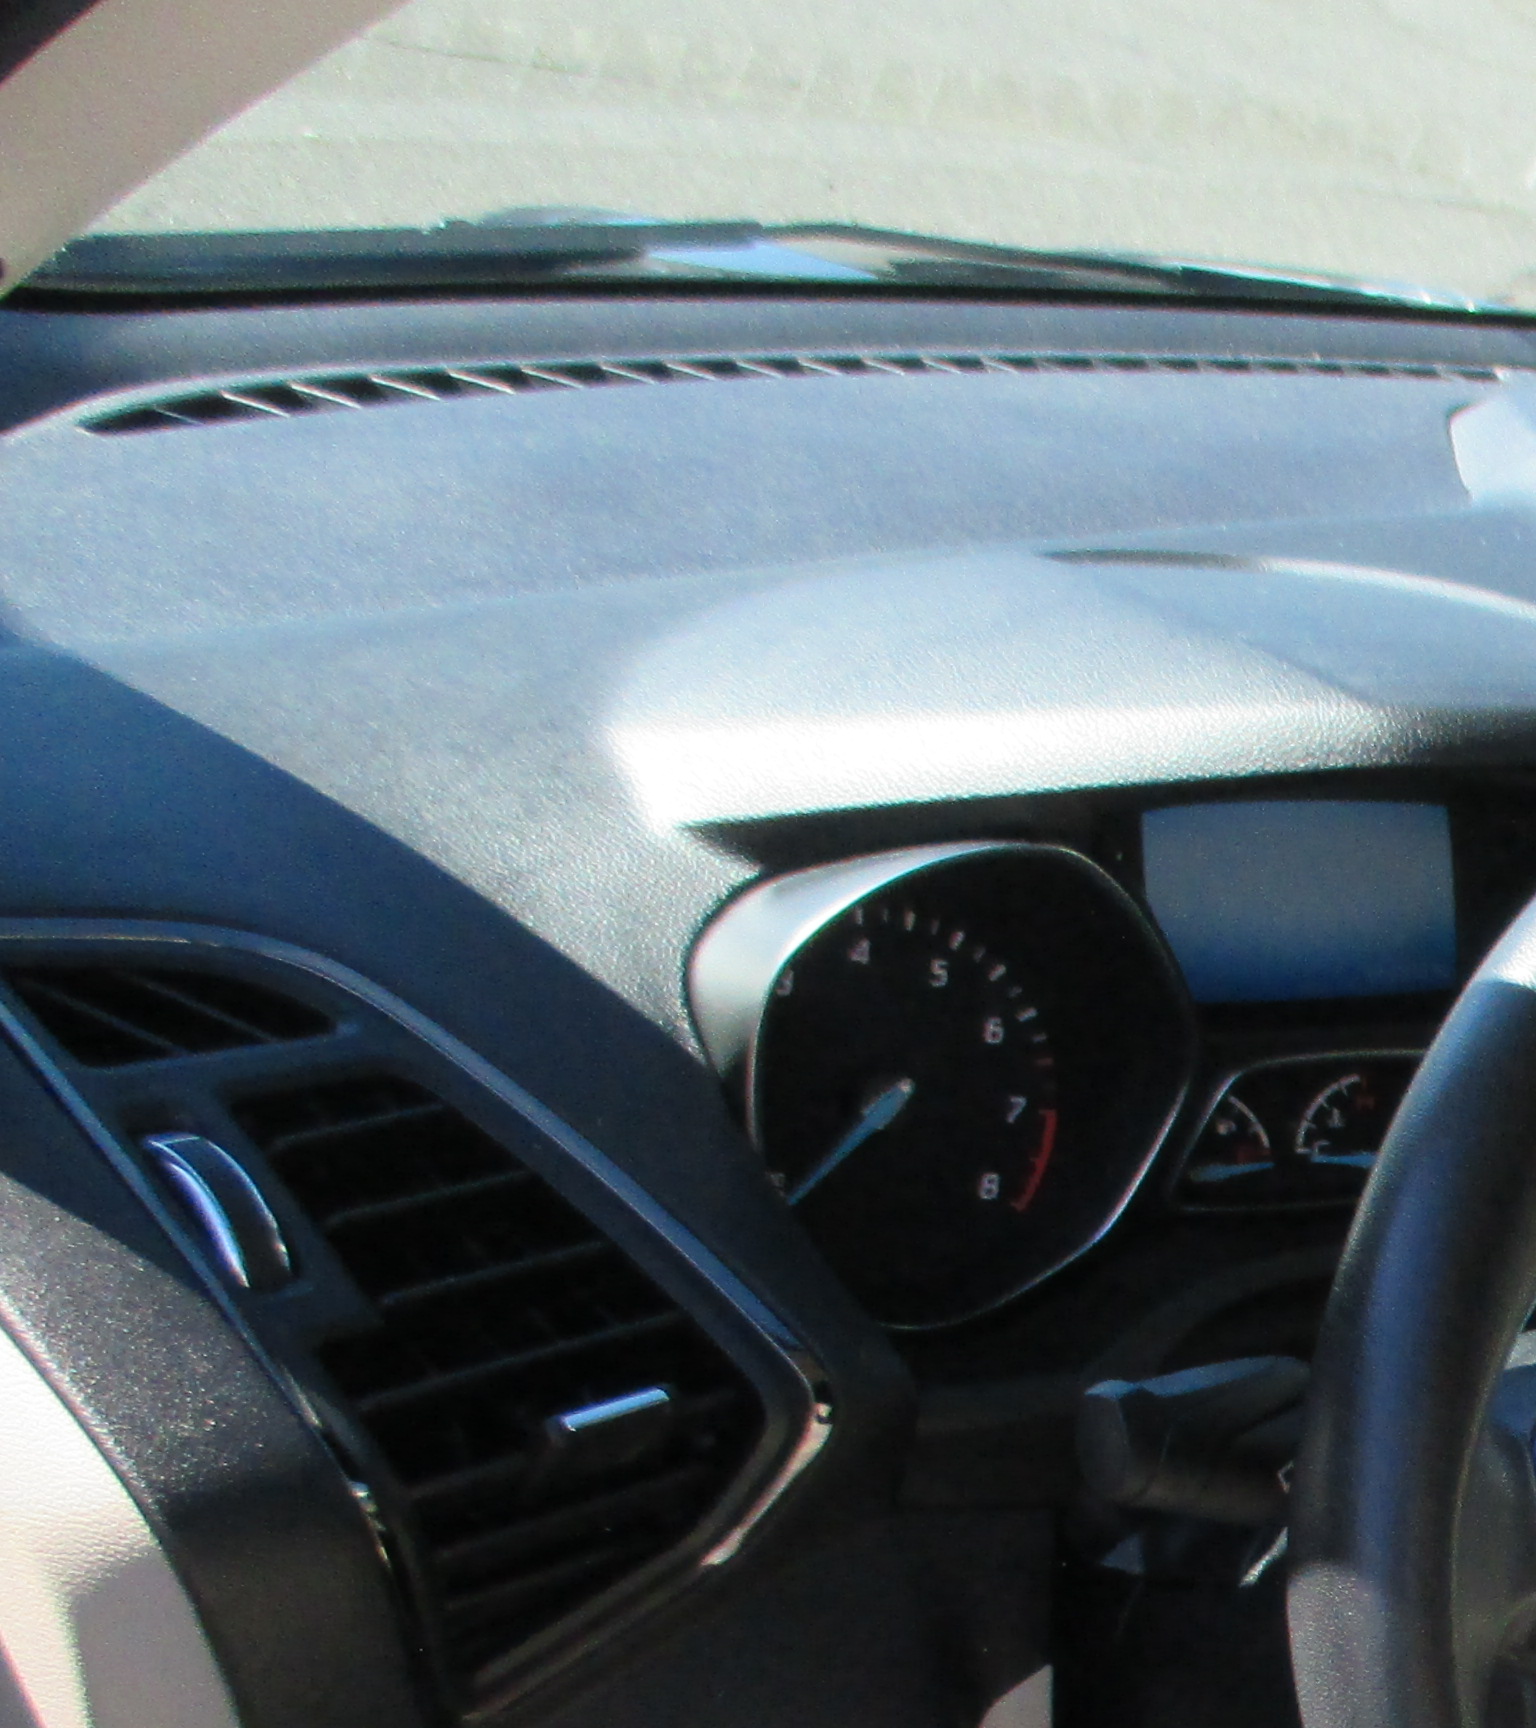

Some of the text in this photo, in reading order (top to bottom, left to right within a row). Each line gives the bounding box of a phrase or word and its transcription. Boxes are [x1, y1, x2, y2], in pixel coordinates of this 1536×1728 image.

[929, 957, 949, 988] 5
[983, 1016, 1004, 1044] 6
[1006, 1095, 1027, 1124] 7
[977, 1172, 1000, 1200] 8
